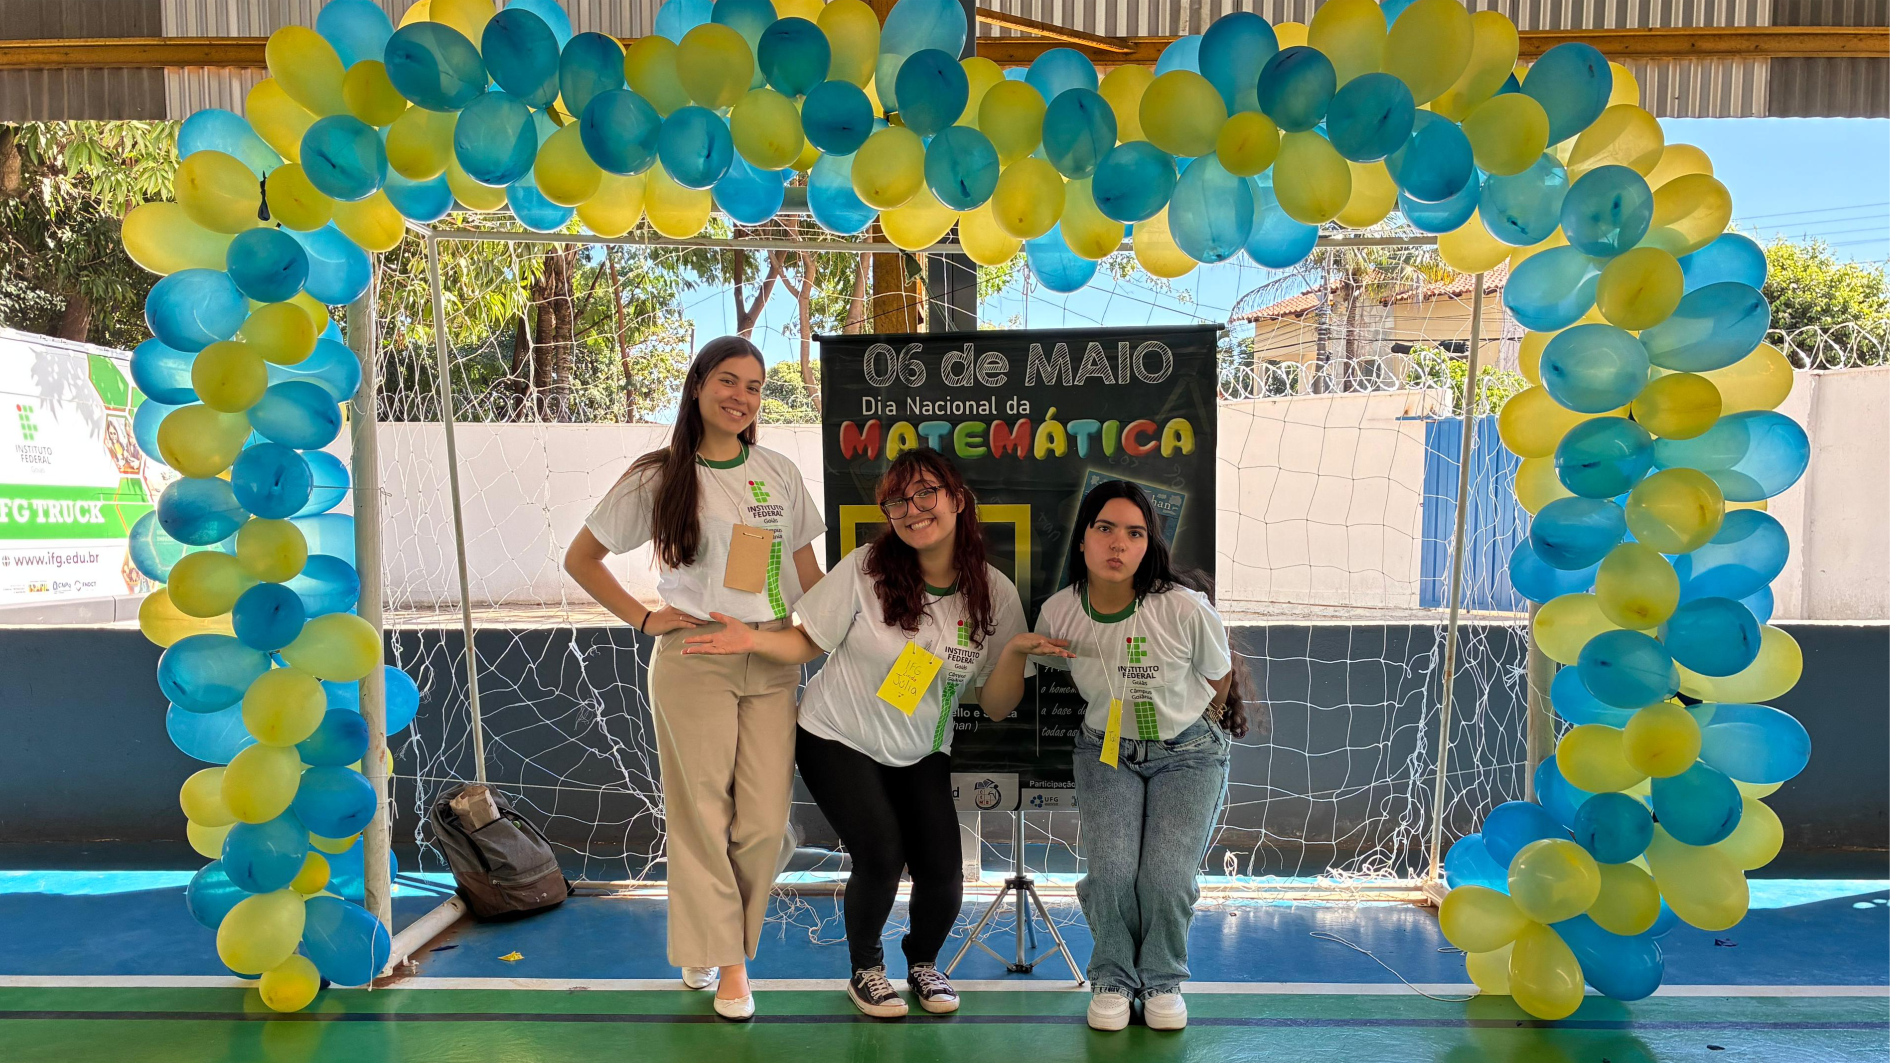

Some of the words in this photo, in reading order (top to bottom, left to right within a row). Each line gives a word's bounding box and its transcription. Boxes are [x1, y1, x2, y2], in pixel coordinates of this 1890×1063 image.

[863, 343, 927, 388] 06
[940, 343, 1010, 387] de
[1024, 340, 1174, 387] MAIO
[862, 396, 897, 416] Dia
[907, 396, 997, 416] Nacional
[1006, 395, 1030, 415] da
[839, 406, 1196, 461] MATEMÁTICA
[15, 444, 53, 456] INSTITUTO
[20, 453, 52, 465] FEDERAL
[32, 498, 105, 524] TRUCK
[747, 505, 784, 513] INSTITUTO
[13, 551, 100, 568] www.ifg.edu.br
[945, 646, 980, 659] INSTITUTO
[1122, 671, 1156, 679] FEDERAL
[1041, 707, 1047, 715] a
[1051, 703, 1072, 715] base
[1041, 725, 1065, 737] todas
[1029, 780, 1076, 789] Participação
